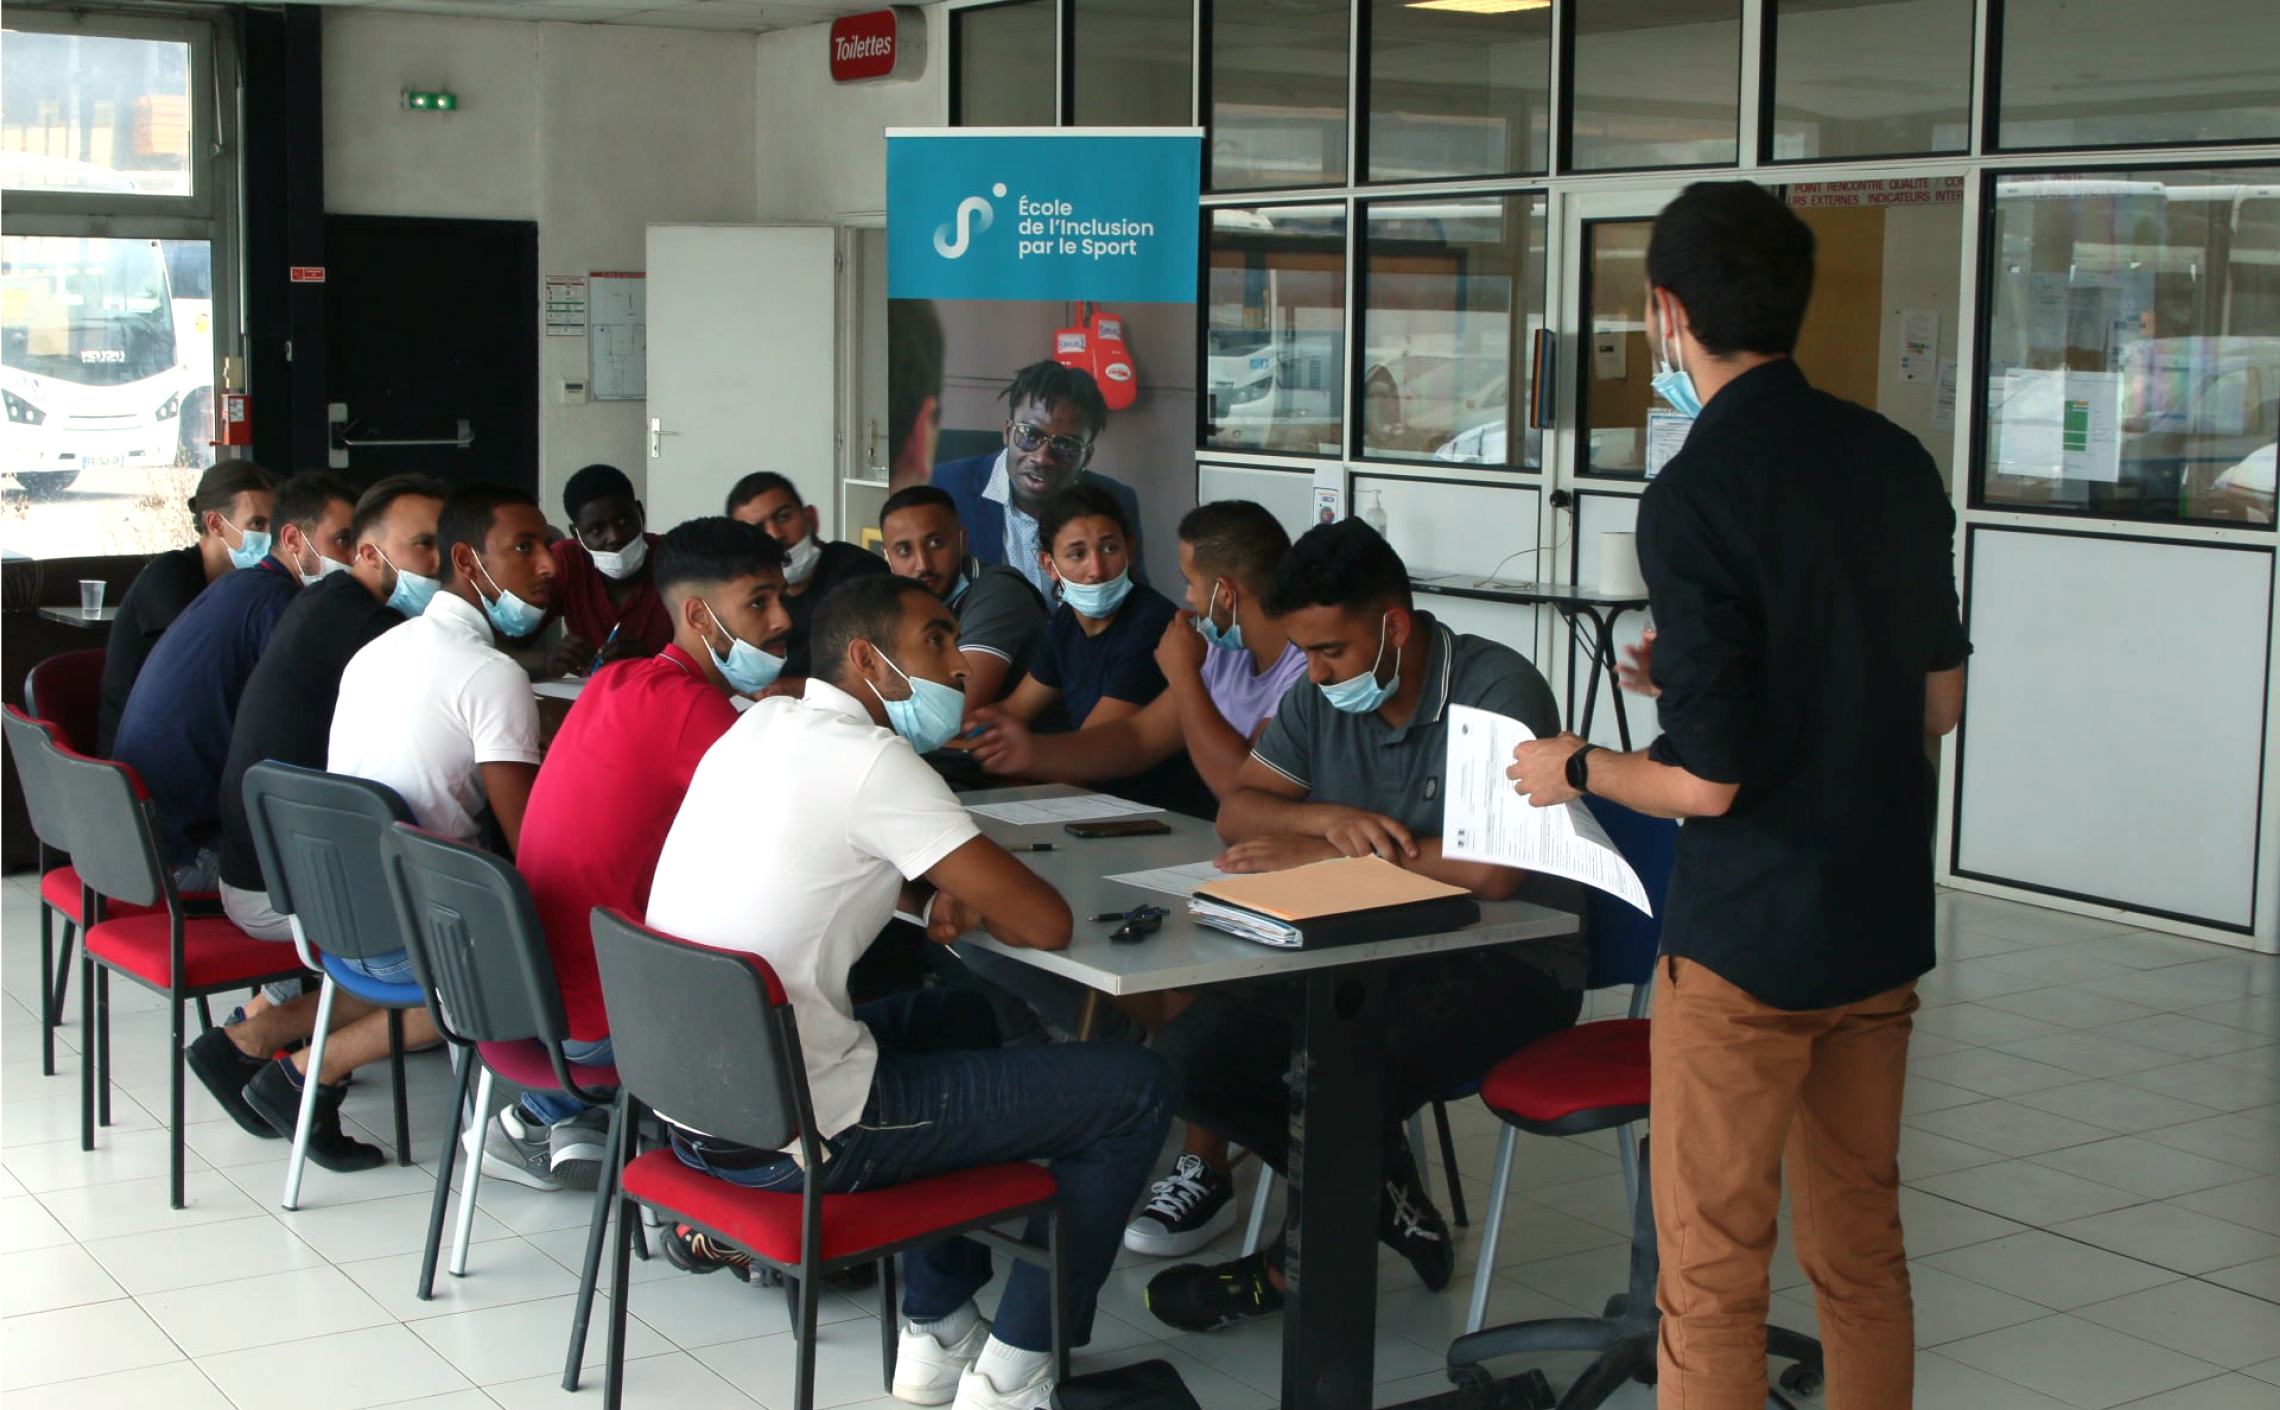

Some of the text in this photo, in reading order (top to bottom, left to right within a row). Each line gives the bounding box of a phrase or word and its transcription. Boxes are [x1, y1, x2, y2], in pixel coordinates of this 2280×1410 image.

[836, 35, 892, 61] Toilettes
[1795, 182, 1821, 193] POINT
[1827, 180, 1885, 192] RENCONTRE
[1889, 178, 1930, 190] QUALITE
[1019, 195, 1073, 216] École
[1811, 194, 1860, 206] EXTERNES
[1868, 190, 1931, 204] INDICATEURS
[1018, 218, 1045, 236] de
[1019, 237, 1137, 260] par le Sport
[81, 350, 126, 364] ISUZU
